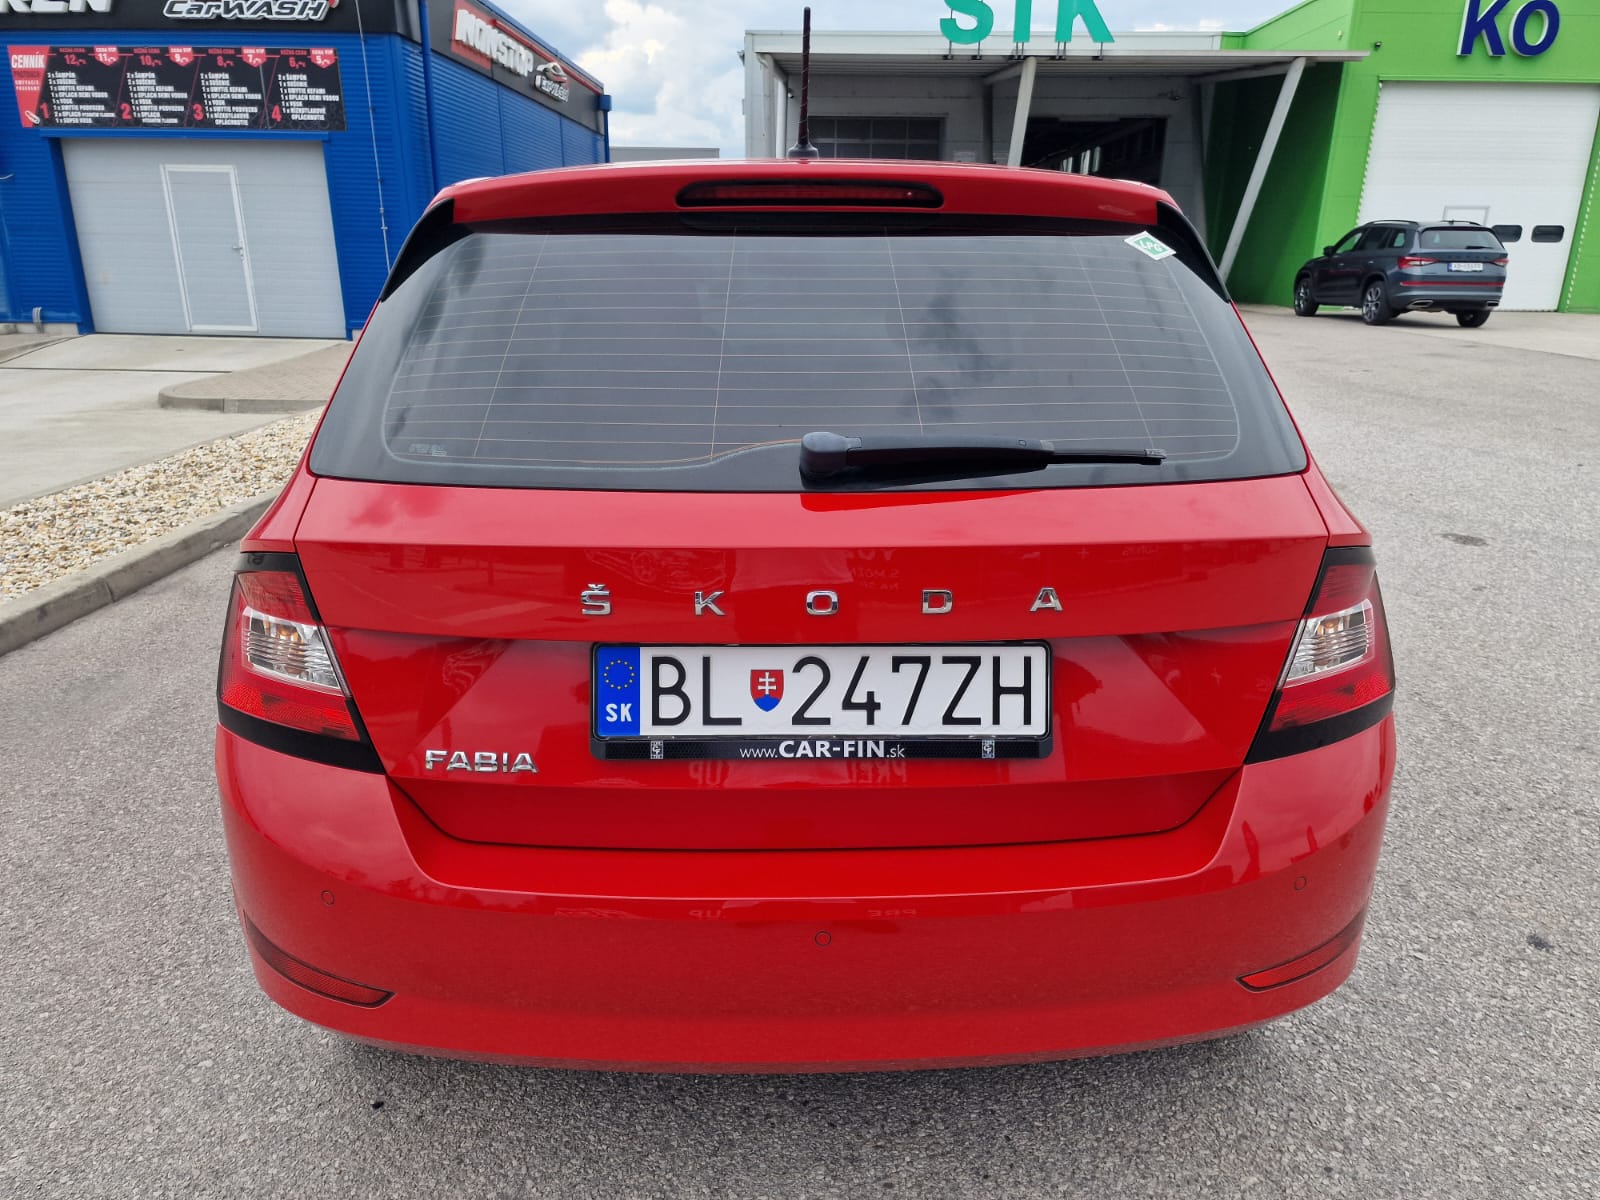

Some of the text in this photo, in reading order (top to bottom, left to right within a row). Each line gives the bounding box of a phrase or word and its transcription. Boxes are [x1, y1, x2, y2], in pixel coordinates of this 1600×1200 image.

[1456, 0, 1560, 56] KO
[455, 9, 534, 77] NONSTOP
[12, 52, 46, 68] CENNÍK
[121, 103, 132, 119] 2
[193, 103, 204, 120] 3
[272, 105, 282, 122] 4
[580, 583, 1064, 616] ŠKODA
[651, 656, 1032, 726] BL 247ZH
[605, 703, 632, 723] SK
[425, 749, 538, 773] FABIA
